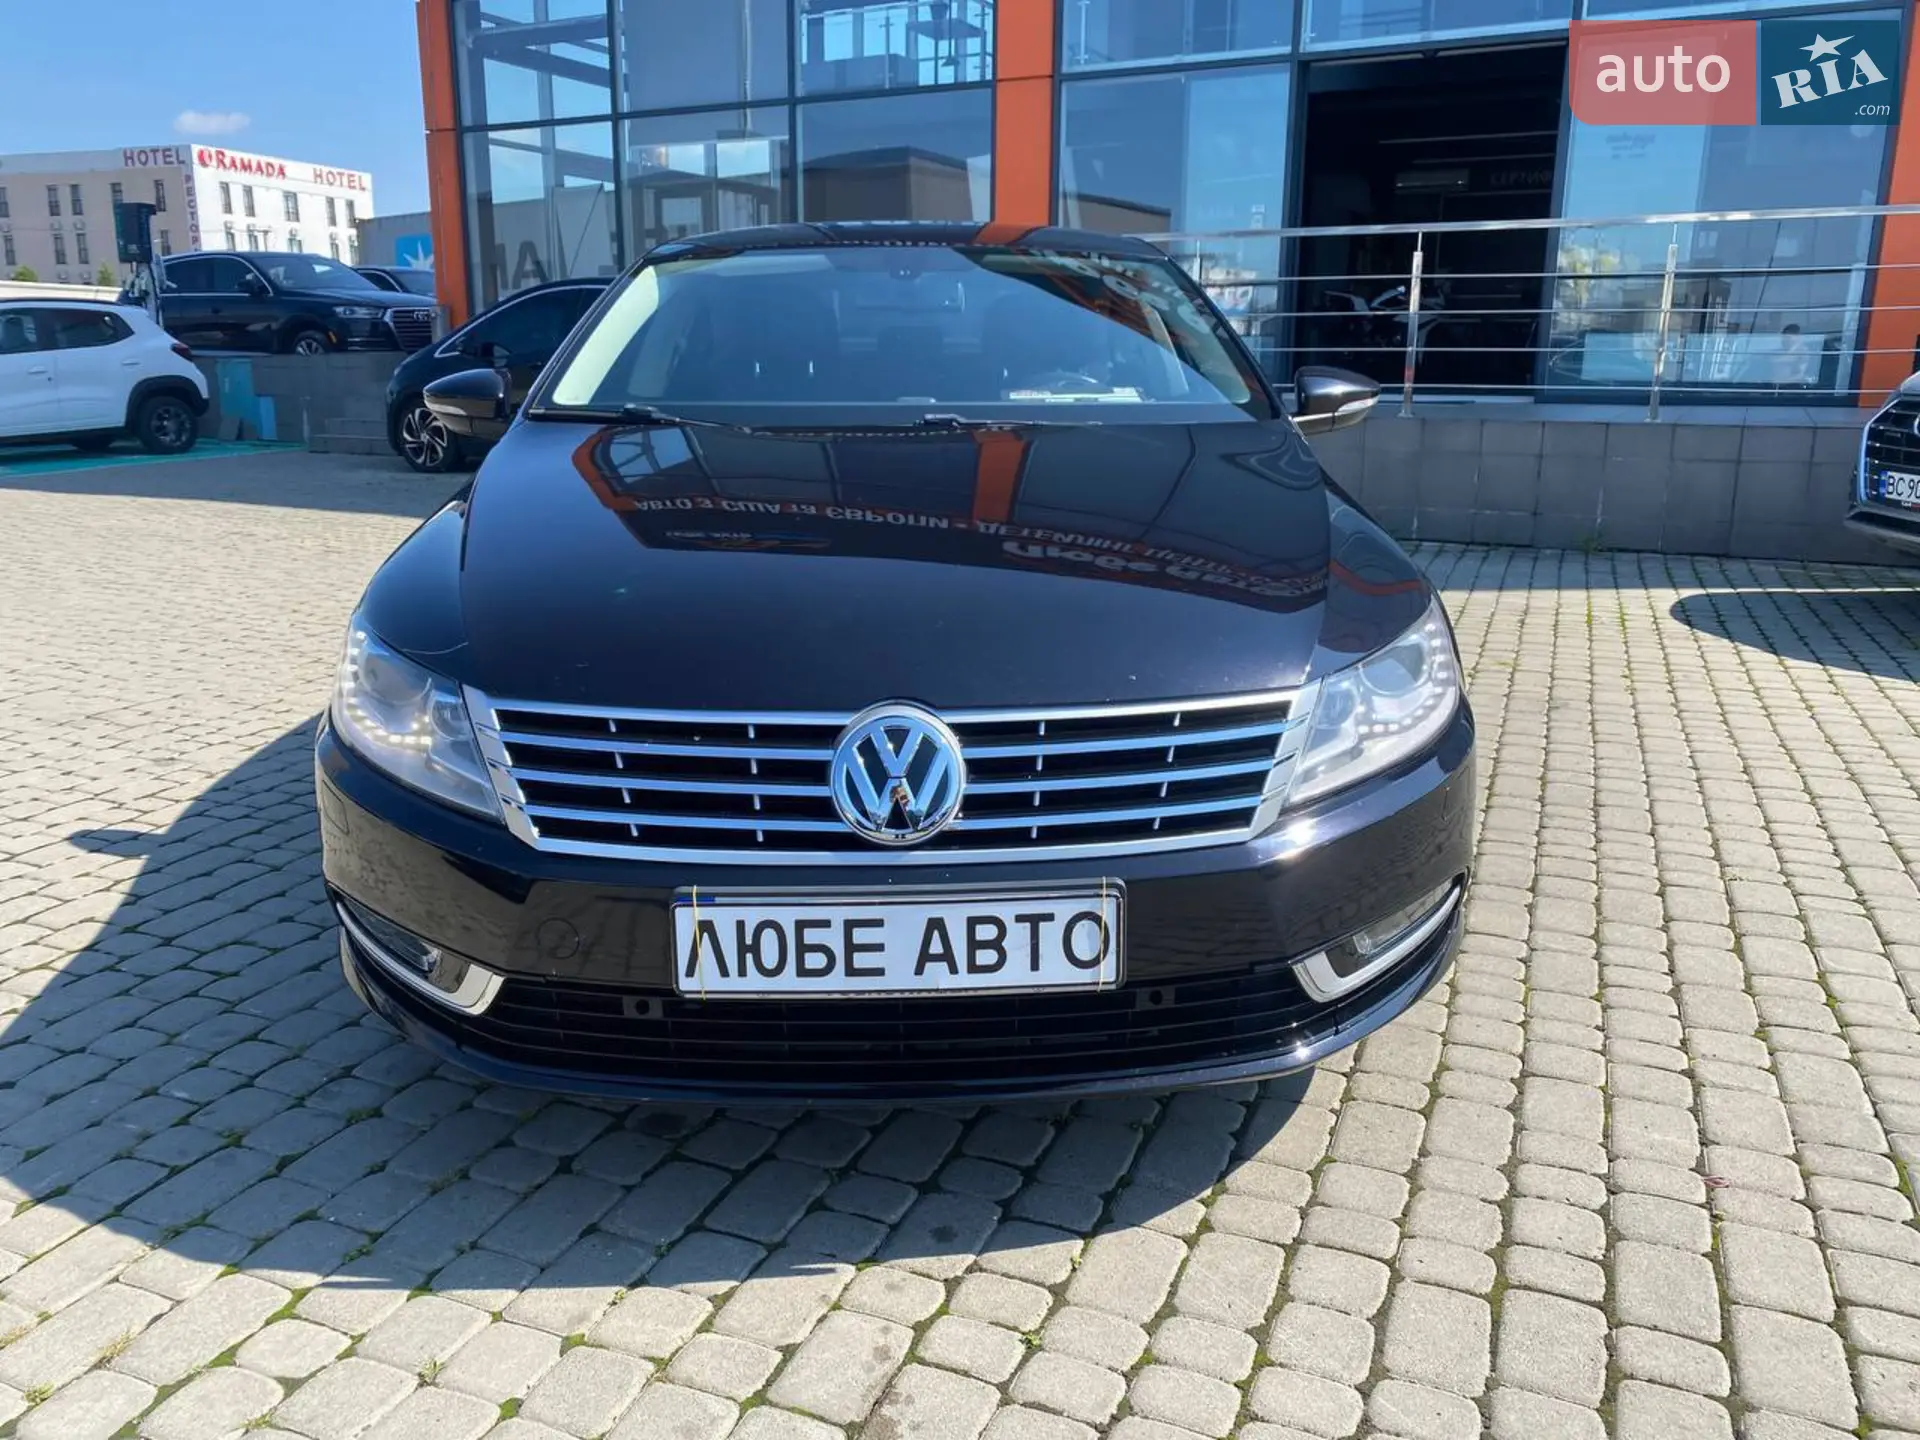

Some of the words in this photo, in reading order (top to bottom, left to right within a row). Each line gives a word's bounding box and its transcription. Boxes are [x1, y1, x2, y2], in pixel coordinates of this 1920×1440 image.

[123, 148, 186, 167] HOTEL
[215, 149, 287, 180] RAMADA
[313, 167, 367, 192] HOTEL
[184, 174, 200, 252] РЕСТОР
[685, 917, 886, 978] ЛЮБЕ
[913, 911, 1111, 976] АВТО
